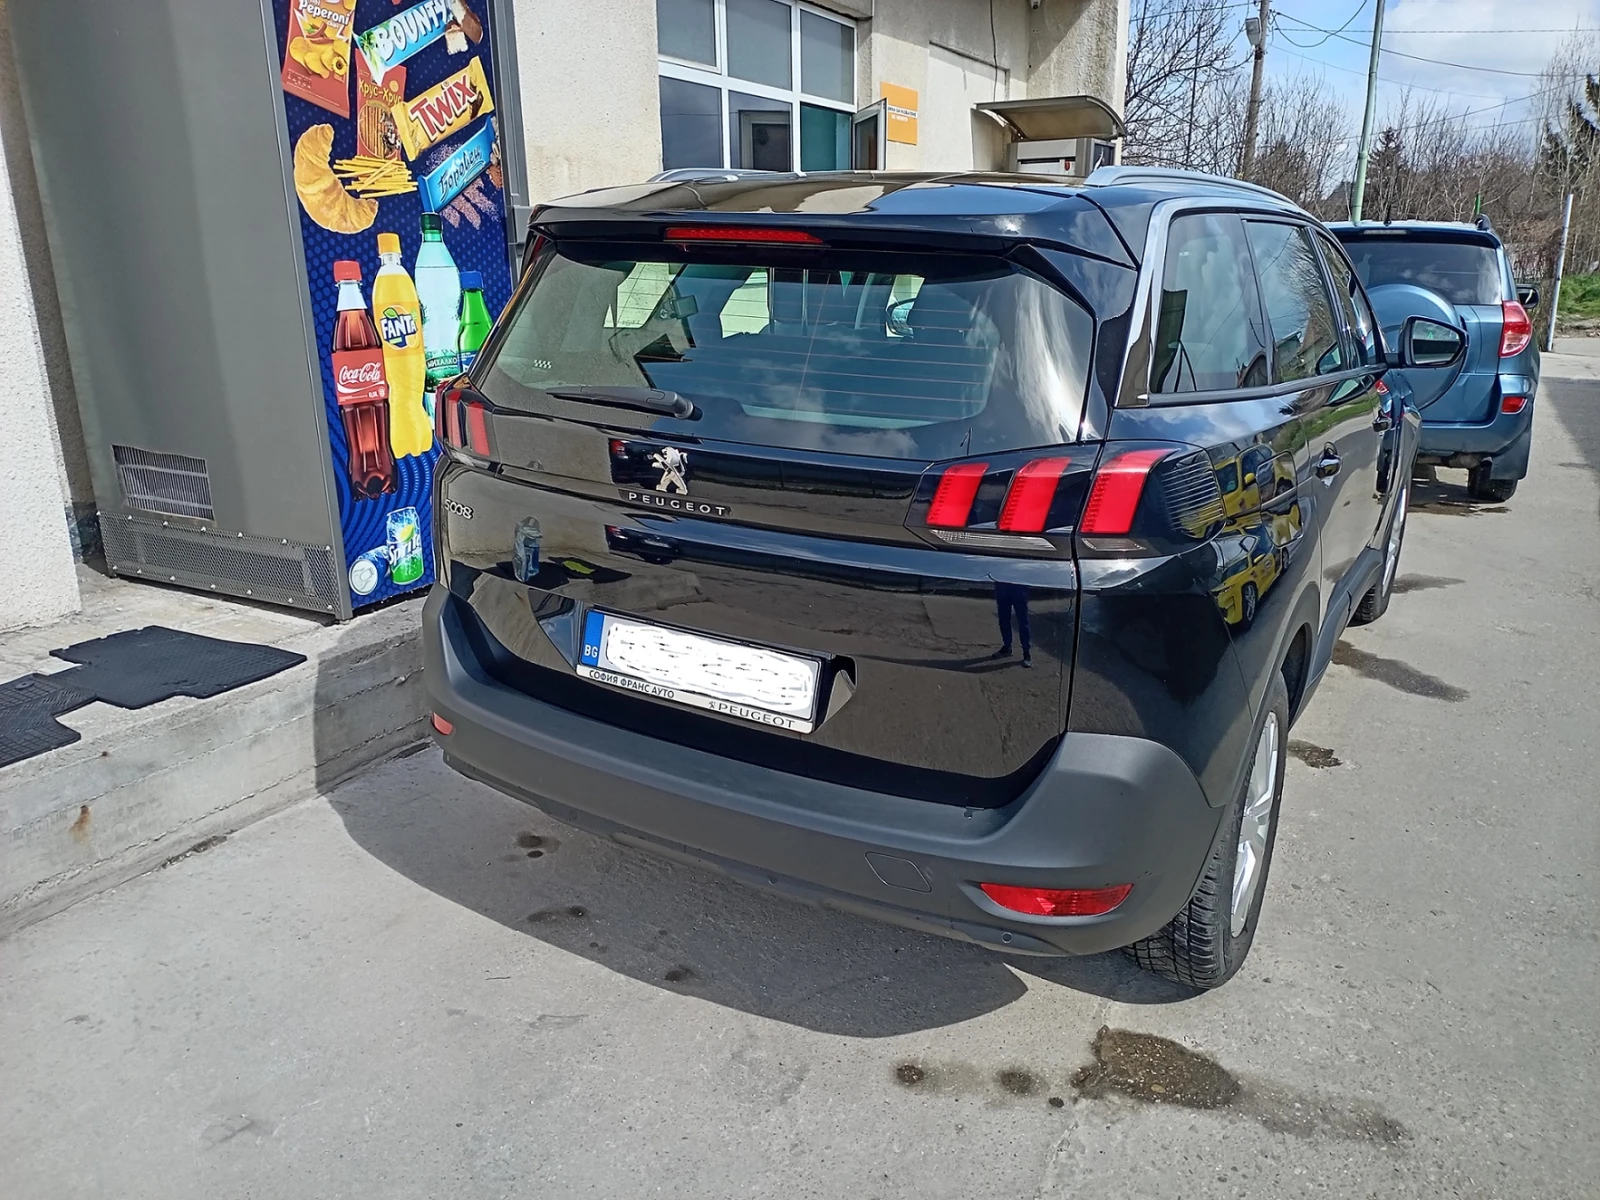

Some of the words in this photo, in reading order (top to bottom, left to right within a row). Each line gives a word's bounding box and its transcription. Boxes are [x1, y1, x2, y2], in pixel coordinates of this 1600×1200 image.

[299, 0, 350, 25] Peperoni
[375, 0, 450, 62] BOUNTY
[380, 314, 417, 341] FANTA
[338, 361, 381, 385] Coca-Cola
[444, 498, 475, 520] 5008
[628, 492, 726, 516] PEUGEOT
[584, 644, 599, 659] BG
[589, 669, 619, 684] СОФИЯ
[620, 678, 651, 694] ФРАНС
[651, 686, 675, 699] АУТО
[718, 702, 796, 729] PEUGEOT
